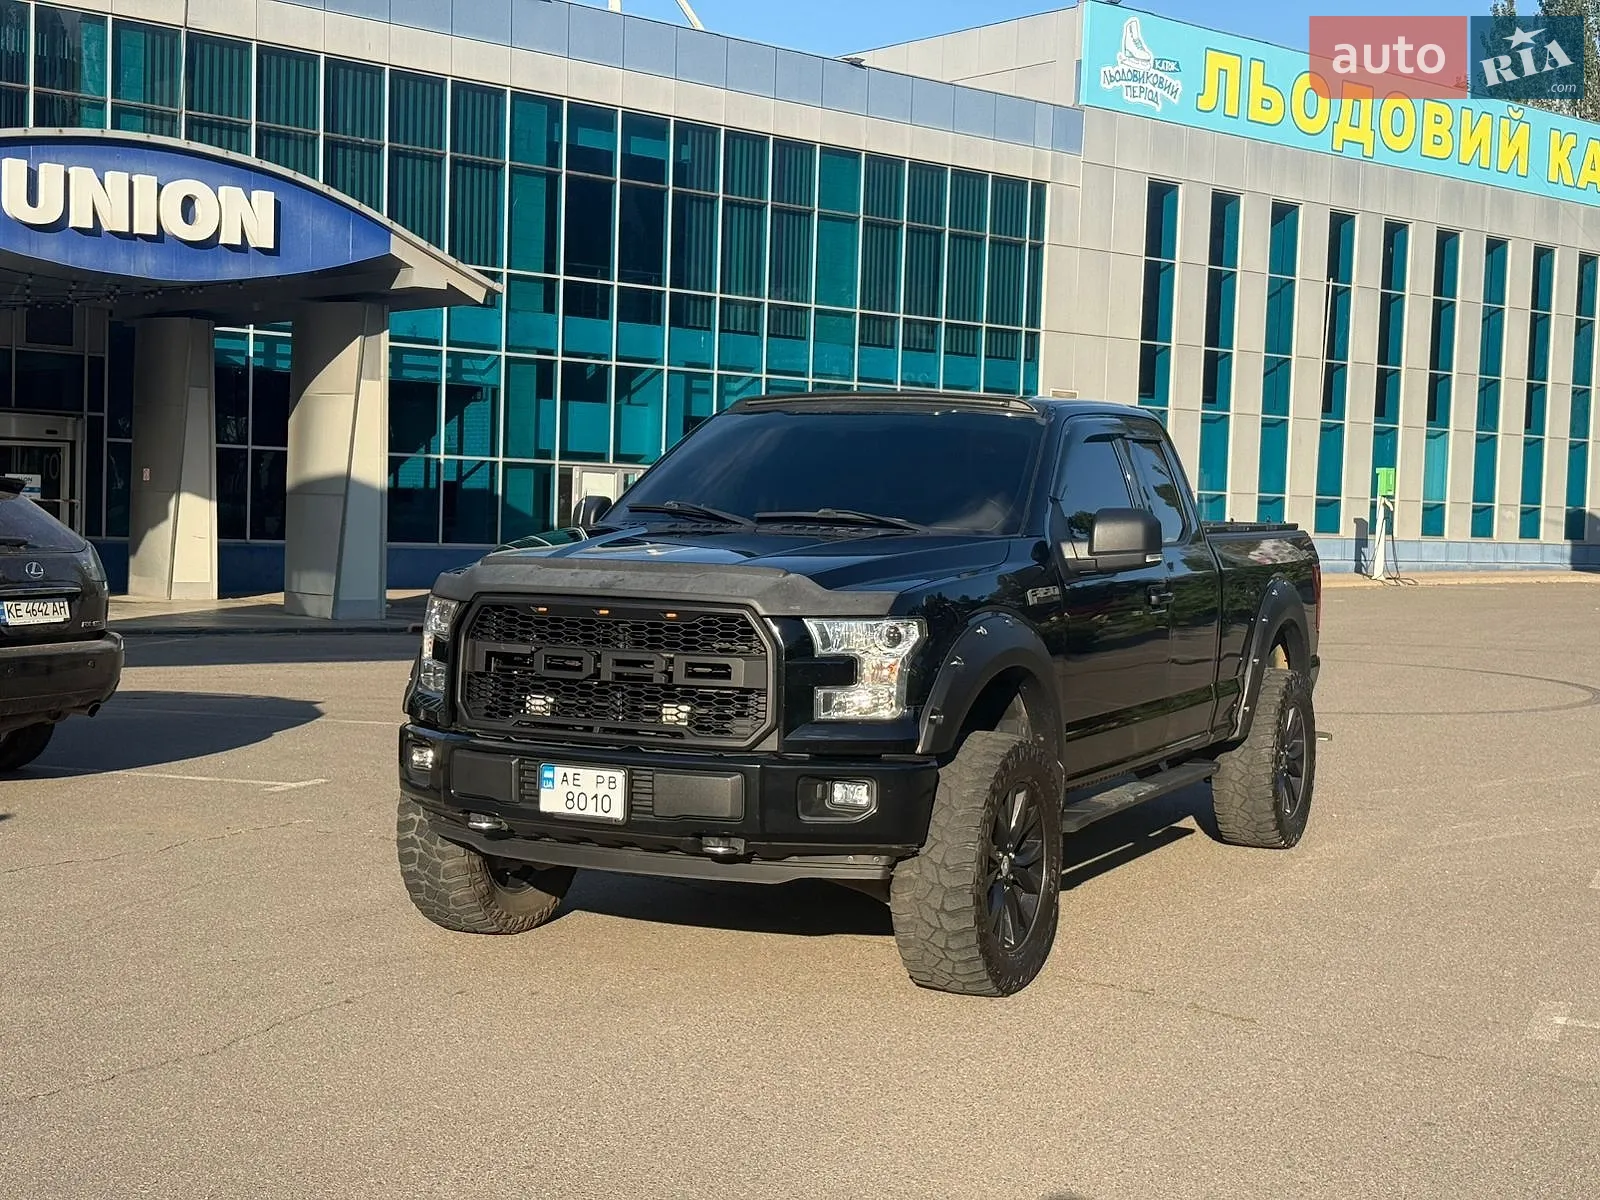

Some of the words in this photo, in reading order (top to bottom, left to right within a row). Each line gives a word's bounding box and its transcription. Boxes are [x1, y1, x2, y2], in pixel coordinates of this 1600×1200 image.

[1103, 68, 1180, 100] ЛЬОДОВИКОВИЙ
[1125, 84, 1160, 105] ПЕРІОД
[1196, 48, 1531, 178] ЛЬОДОВИЙ
[1, 157, 275, 249] UNION
[6, 603, 24, 619] KE
[25, 602, 50, 618] 4642
[52, 601, 67, 616] AH
[560, 772, 582, 787] AE
[596, 775, 617, 790] PB
[565, 791, 612, 814] 8010
